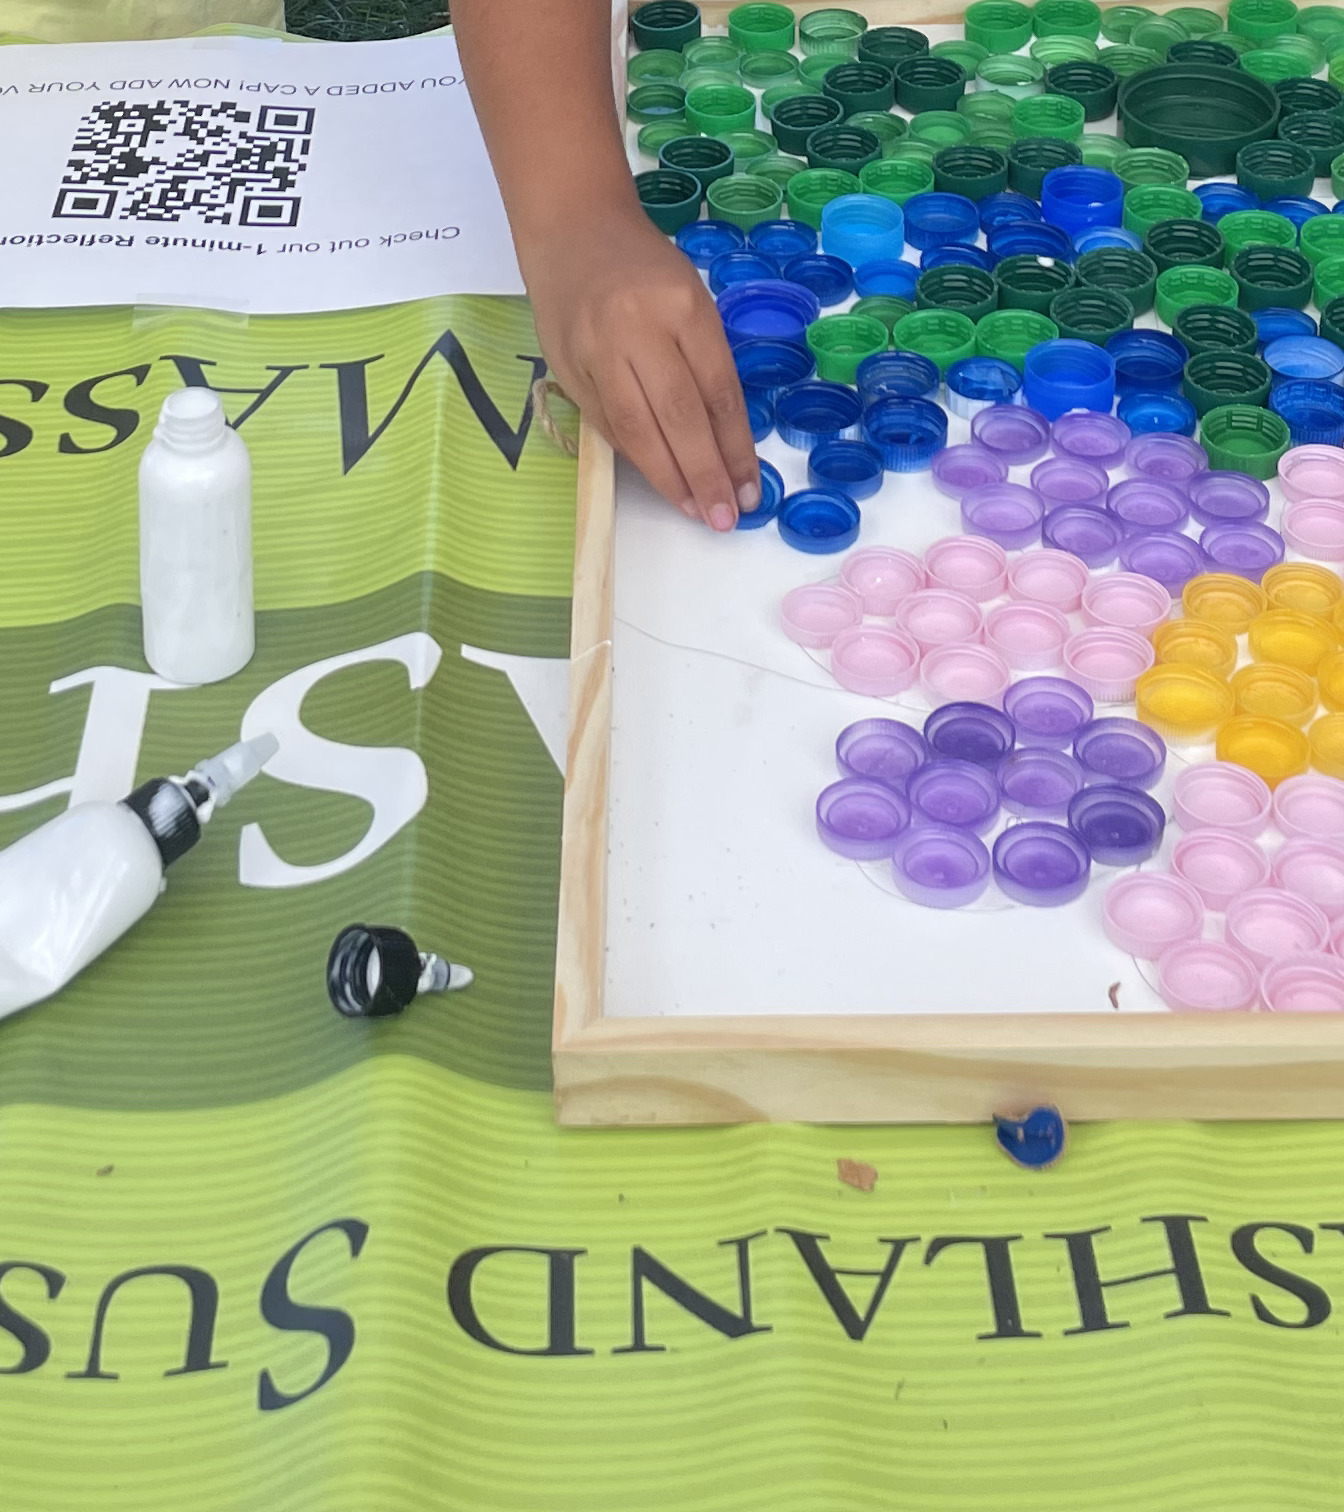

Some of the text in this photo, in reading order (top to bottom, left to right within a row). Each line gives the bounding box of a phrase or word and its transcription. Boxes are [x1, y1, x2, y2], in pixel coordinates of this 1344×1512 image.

[28, 81, 101, 94] YOUR
[109, 79, 163, 90] ADD
[167, 77, 231, 90] NOW
[239, 79, 297, 96] CAP!
[303, 85, 322, 96] A
[326, 79, 415, 96] ADDED
[378, 226, 461, 248] Check
[145, 234, 268, 256] 1-minute
[276, 241, 321, 255] our
[328, 237, 370, 254] out
